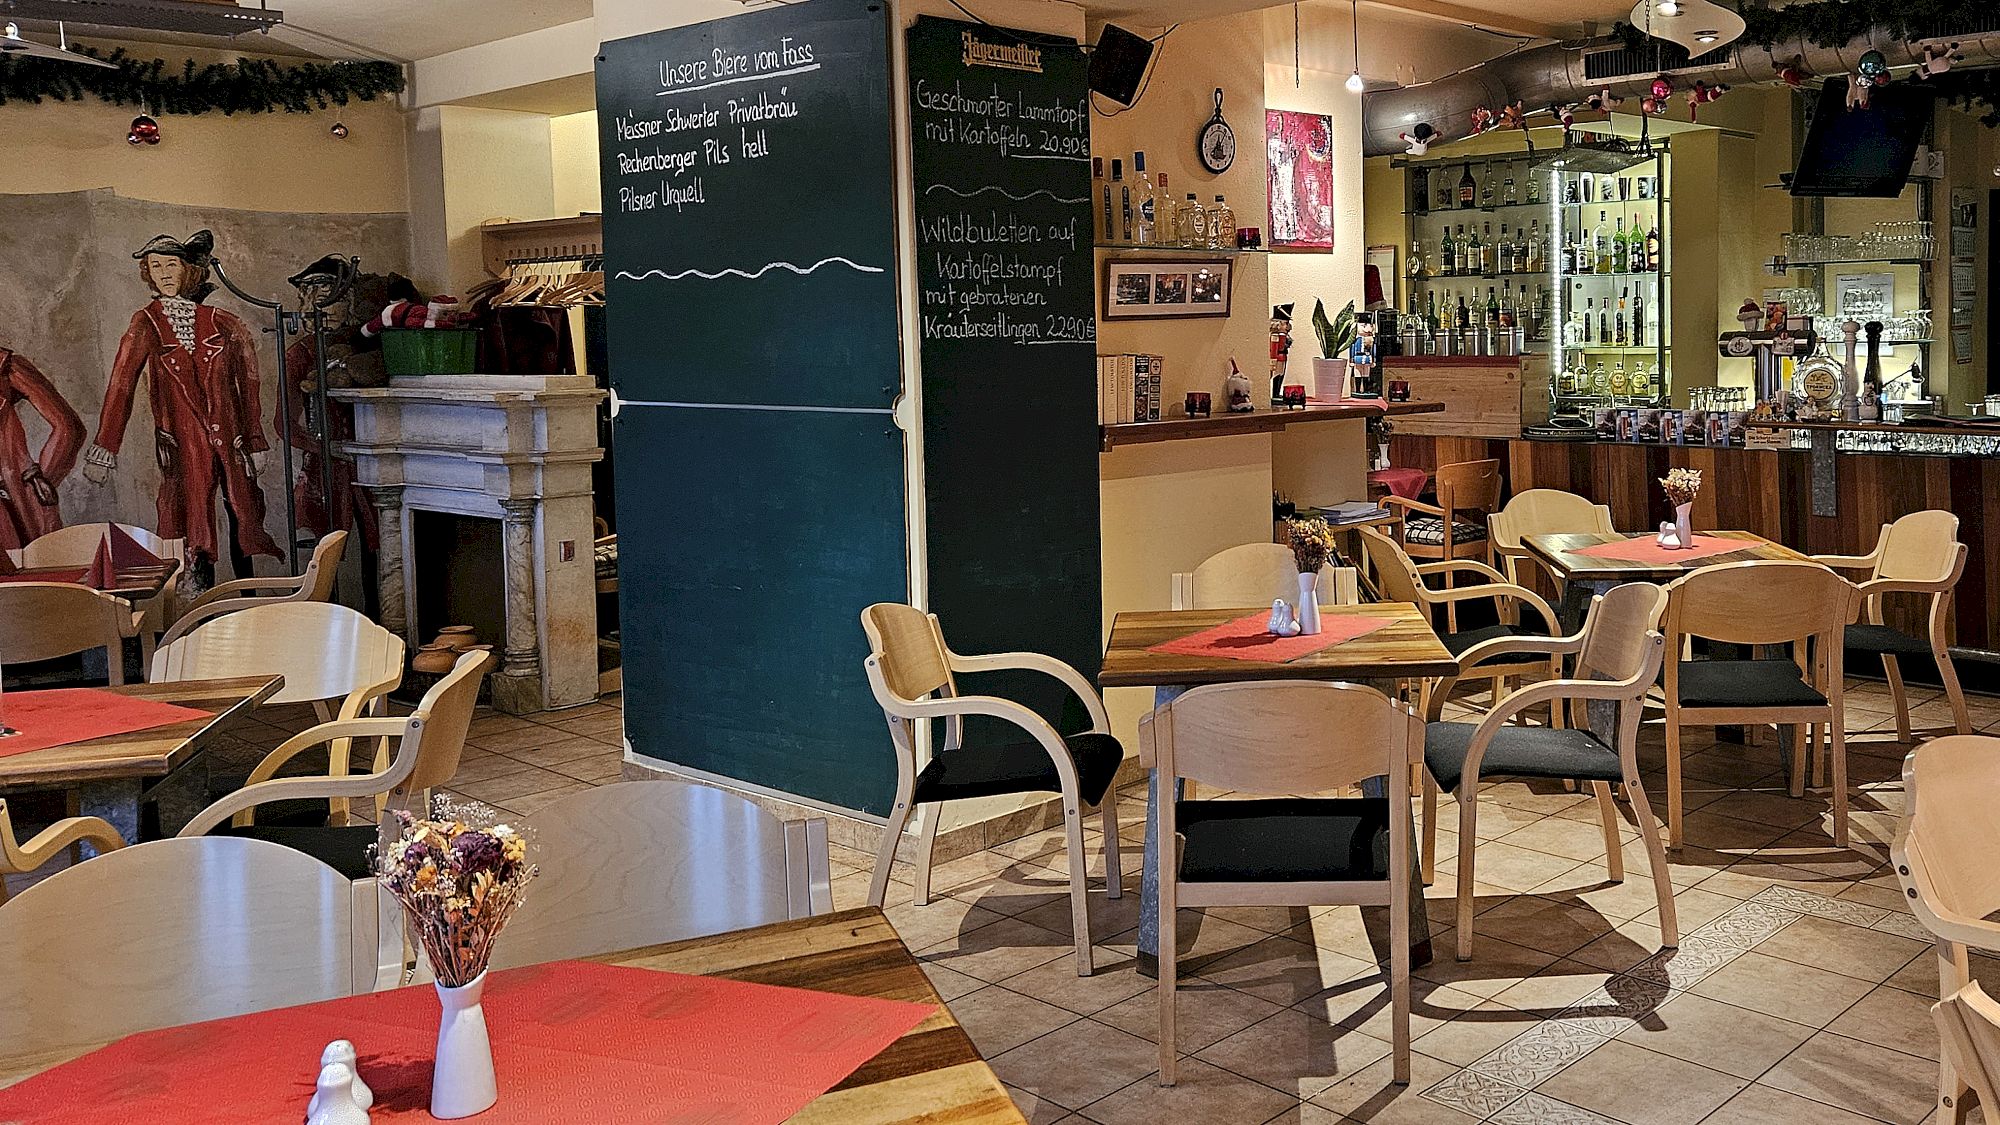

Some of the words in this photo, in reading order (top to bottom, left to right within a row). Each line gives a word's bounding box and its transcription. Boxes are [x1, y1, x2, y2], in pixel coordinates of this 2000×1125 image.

[660, 61, 707, 88] Unsere
[712, 48, 748, 78] Biere
[754, 48, 781, 71] vom
[781, 37, 815, 65] Fass
[962, 31, 1043, 73] Jägermeister
[616, 109, 663, 141] Meissner
[665, 104, 719, 133] Schwerter
[727, 86, 799, 122] Privatbräu
[917, 79, 1013, 118] Geschmorter
[1018, 91, 1086, 133] Lammtopf
[617, 147, 698, 177] Rechenberger
[703, 139, 730, 166] Pils
[741, 127, 770, 159] hell
[926, 119, 954, 143] mit
[960, 117, 1032, 158] Kartoffeln
[619, 184, 658, 213] Pilsner
[660, 176, 706, 213] Urquell
[921, 211, 1042, 244] Wildbuletten
[1048, 217, 1077, 251] auf
[937, 251, 1063, 287] Kartoffelstampf
[926, 283, 957, 305] mit
[960, 283, 1047, 314] gebratenen
[925, 311, 1041, 345] Kräuterseitlingen
